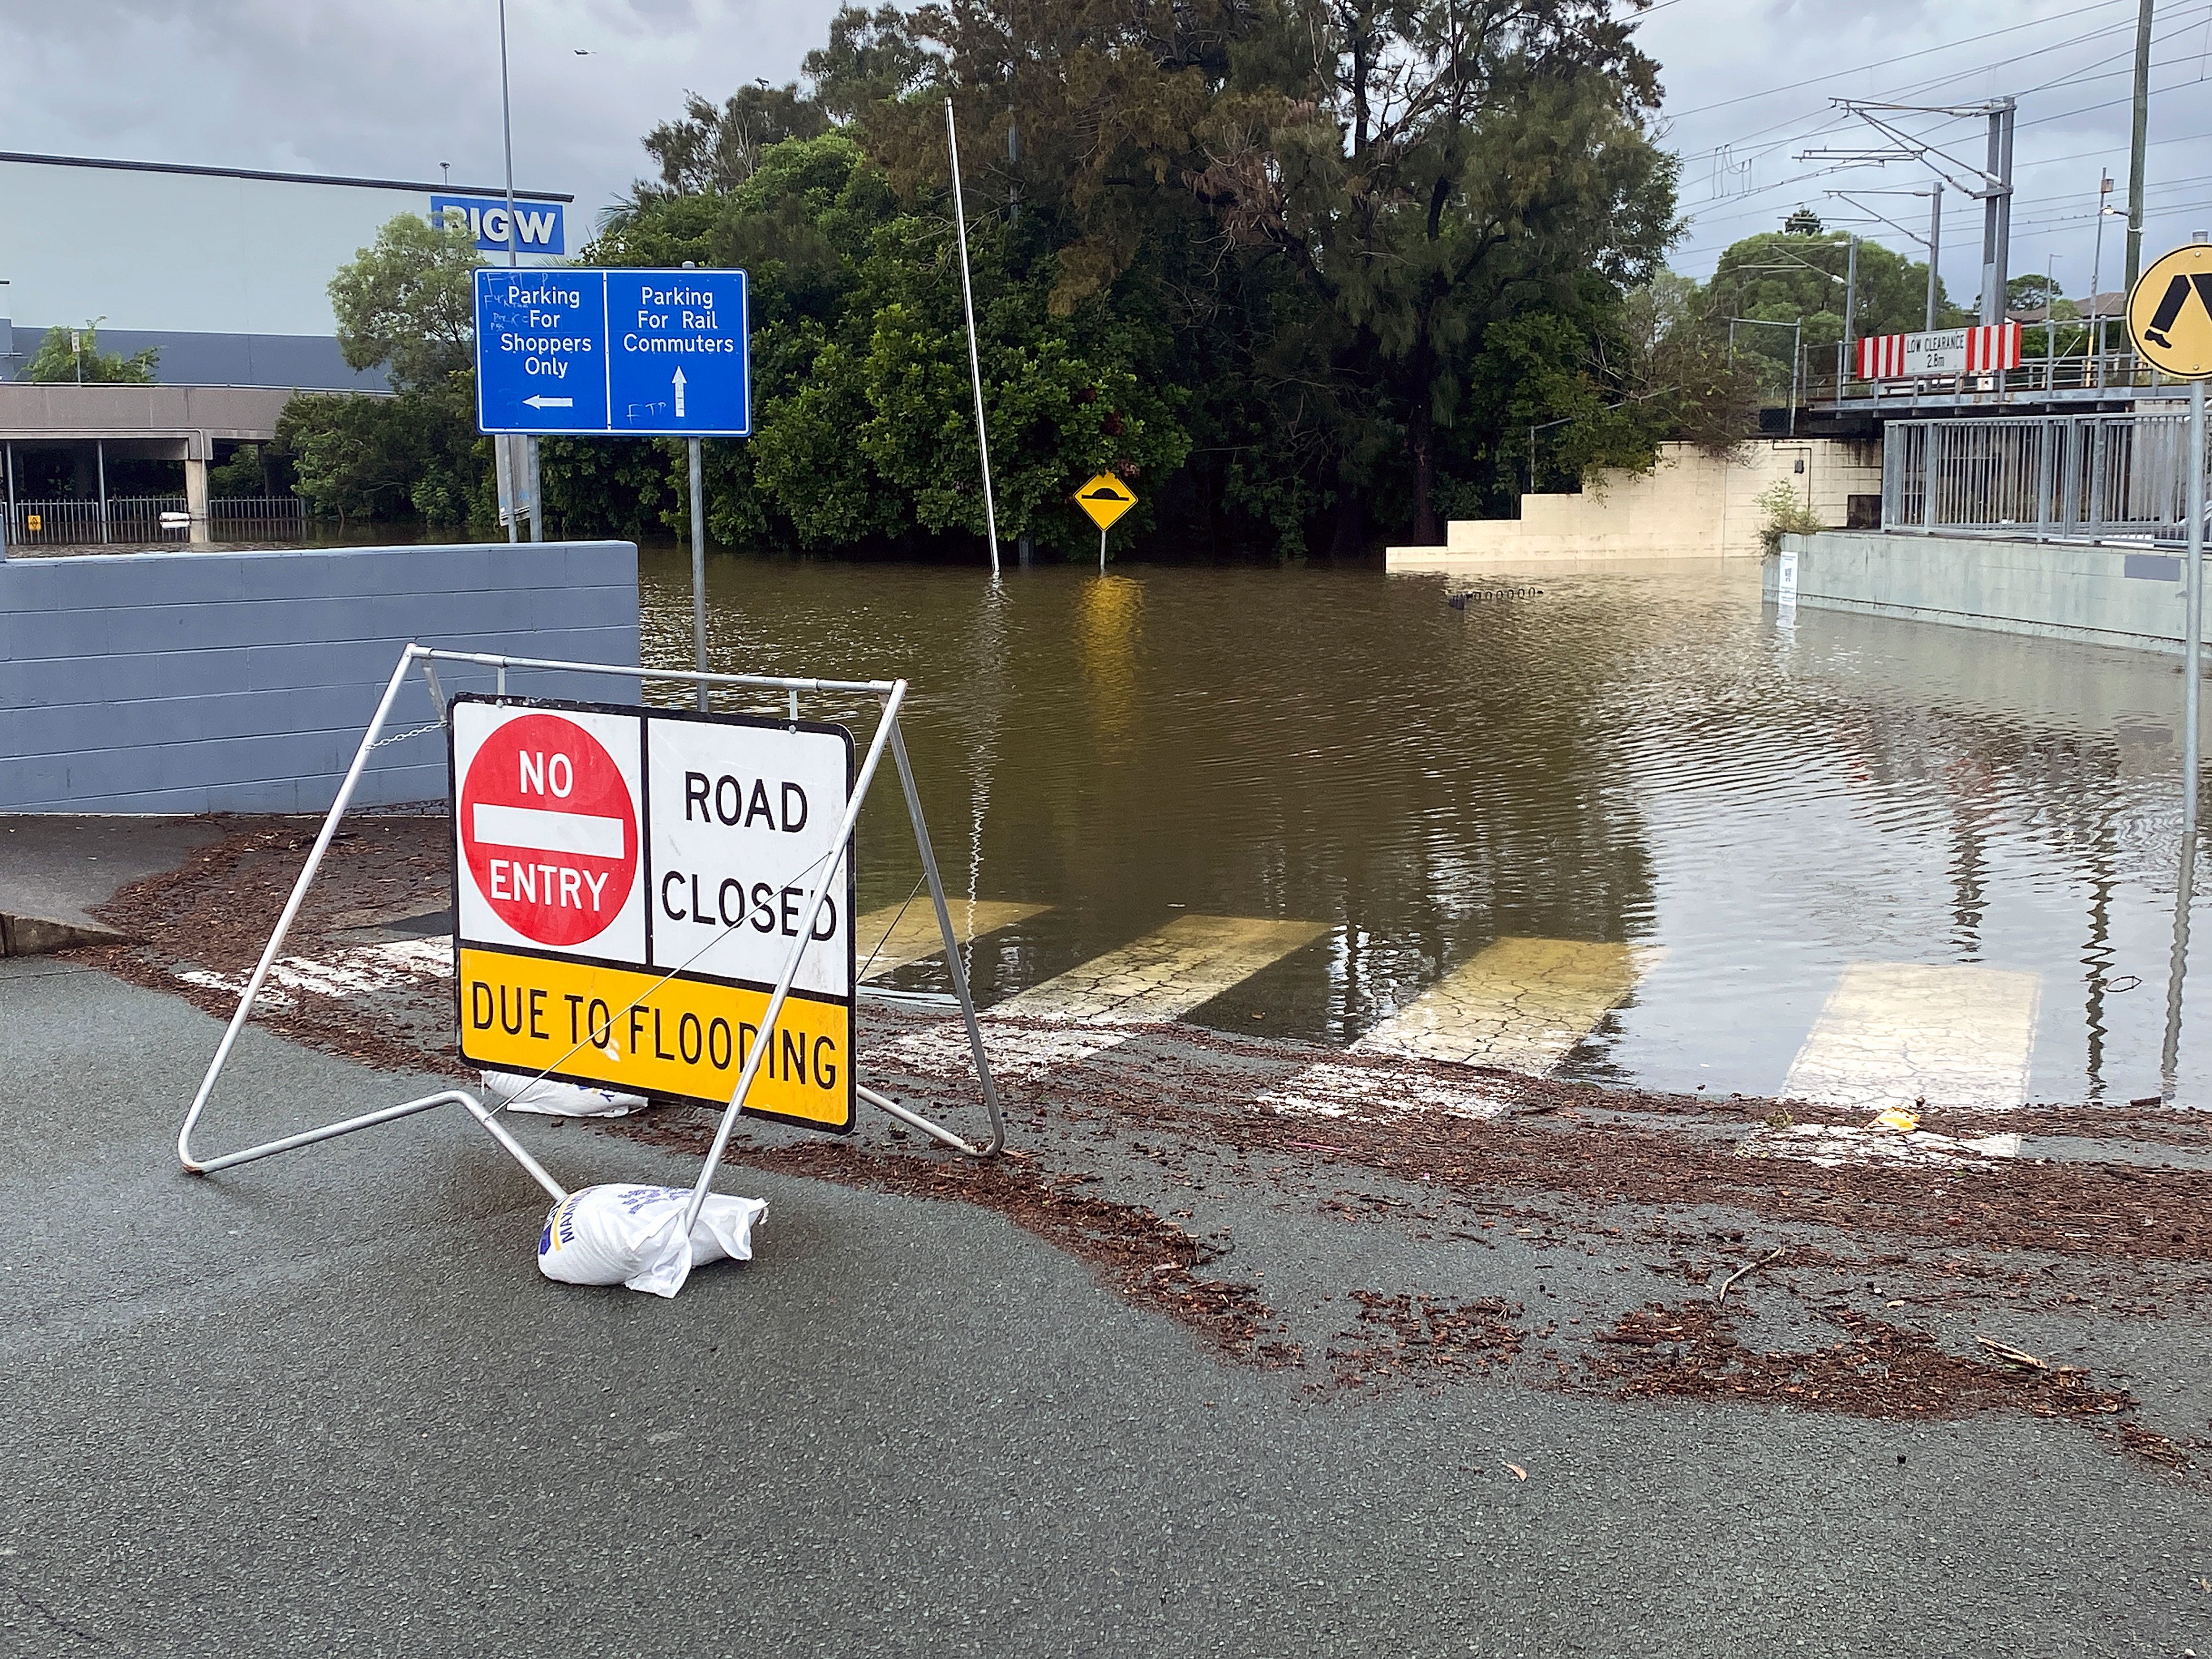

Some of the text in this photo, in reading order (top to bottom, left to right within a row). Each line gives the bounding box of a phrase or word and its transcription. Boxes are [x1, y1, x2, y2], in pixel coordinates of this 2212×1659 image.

[508, 285, 580, 309] Parking
[641, 286, 713, 309] Parking
[530, 310, 560, 328] For
[638, 310, 718, 329] For Rail
[500, 333, 592, 355] Shoppers
[624, 333, 734, 352] Commuters
[1907, 334, 1964, 353] LOW CLEARANCE
[525, 356, 568, 379] Only
[519, 750, 573, 798] NO
[685, 771, 808, 833] ROAD
[490, 859, 609, 912] ENTRY
[662, 870, 837, 941] CLOSED
[472, 981, 837, 1090] DUE TO FLOODING
